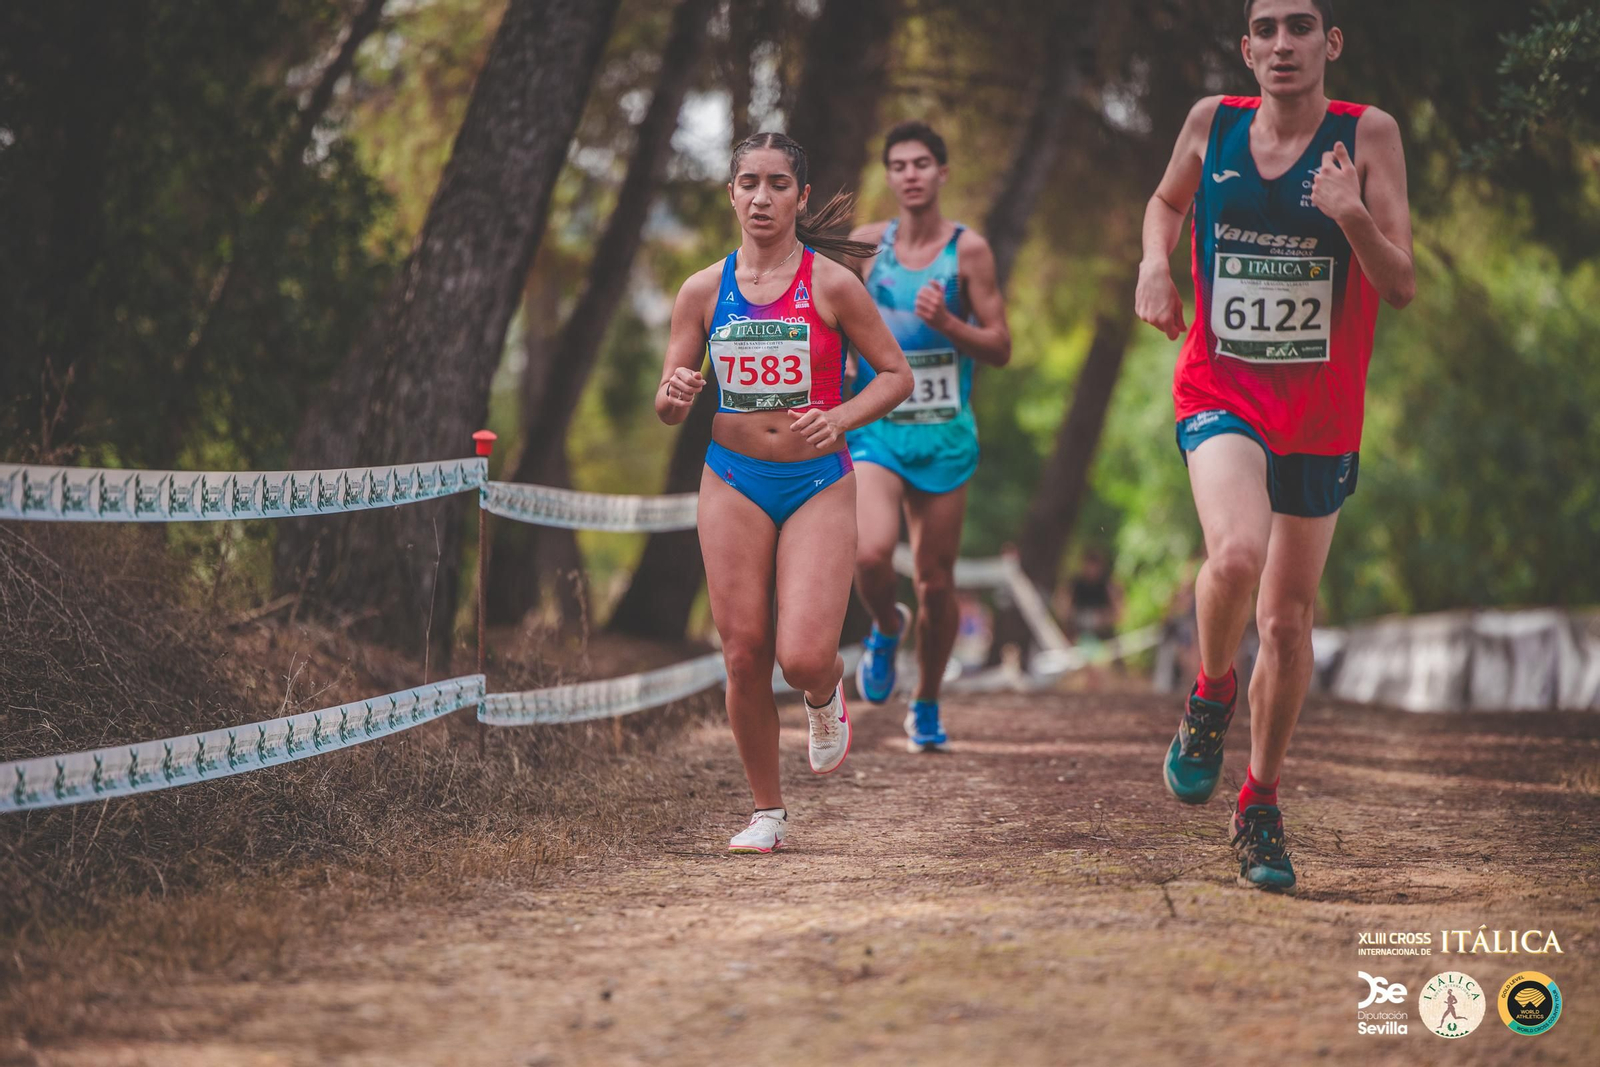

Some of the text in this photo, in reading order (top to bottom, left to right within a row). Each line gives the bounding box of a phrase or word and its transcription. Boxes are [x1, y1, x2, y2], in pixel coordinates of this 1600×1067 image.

[1214, 222, 1318, 249] Vanessa
[1247, 258, 1303, 275] ITÁLICA
[1223, 297, 1321, 333] 6122
[736, 322, 783, 336] ITÁLICA
[719, 355, 803, 386] 7583
[907, 377, 951, 403] 31
